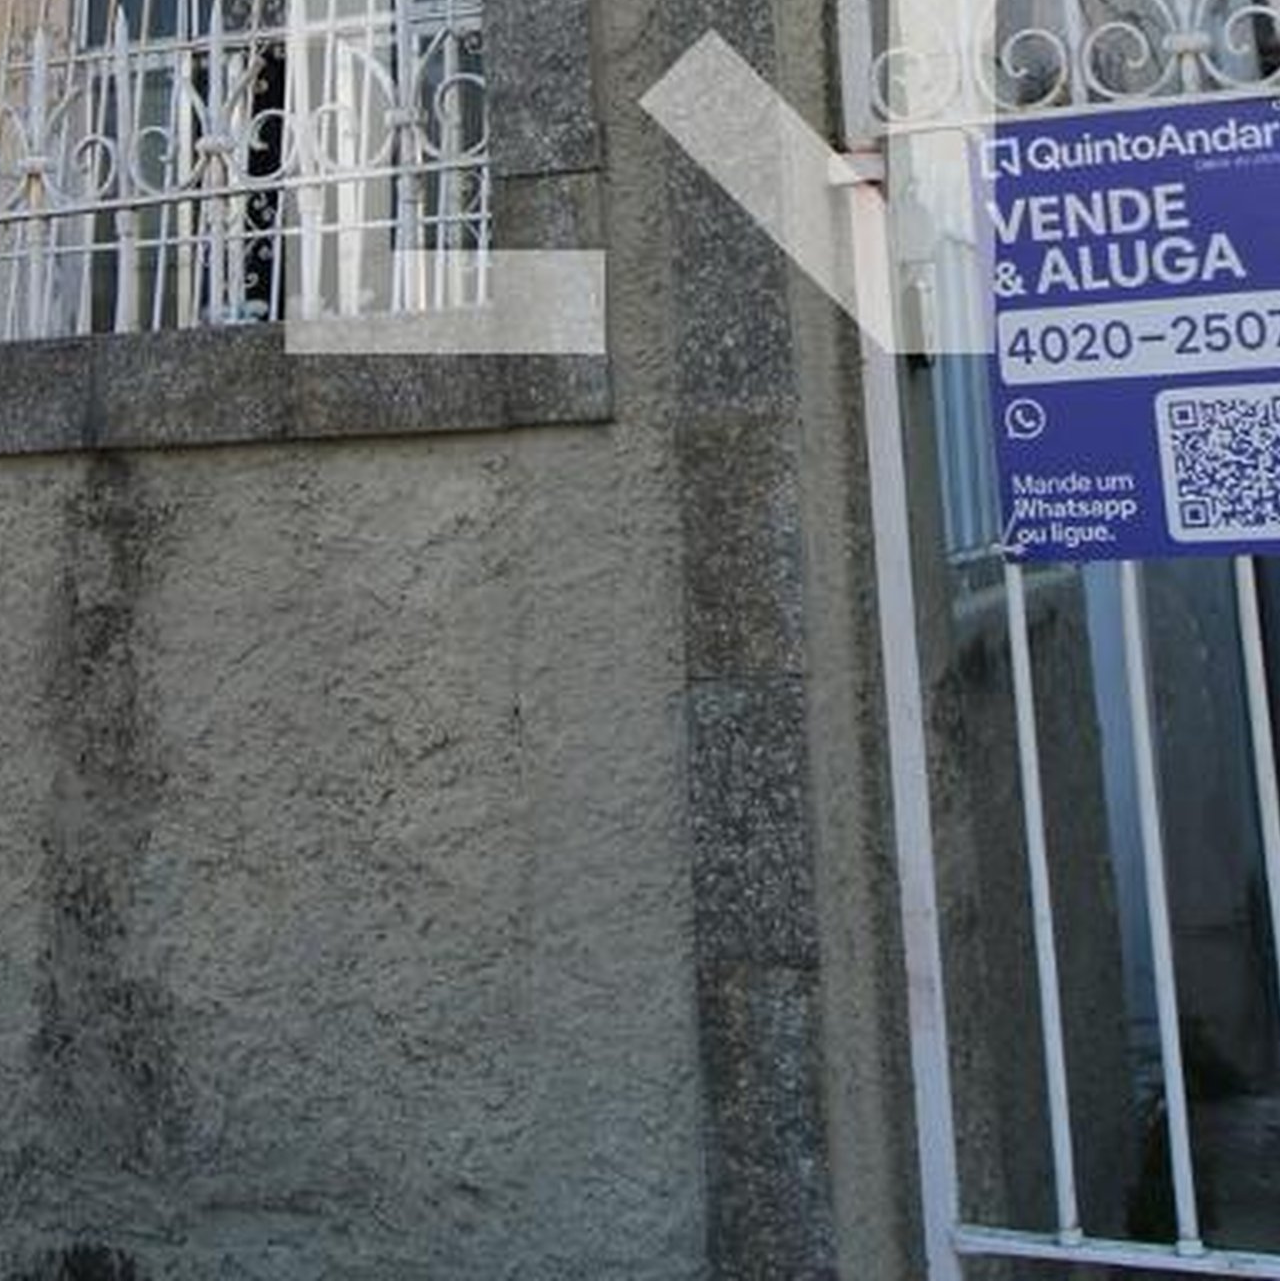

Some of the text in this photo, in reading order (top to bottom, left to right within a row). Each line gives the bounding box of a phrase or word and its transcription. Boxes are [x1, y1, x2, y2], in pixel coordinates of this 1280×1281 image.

[1028, 118, 1280, 171] QuintoAndar
[985, 184, 1191, 245] VENDE
[993, 233, 1247, 297] & ALUGA
[1012, 471, 1136, 495] Mande um
[1014, 498, 1138, 521] Whatsapp
[1017, 521, 1116, 548] ou ligue.
